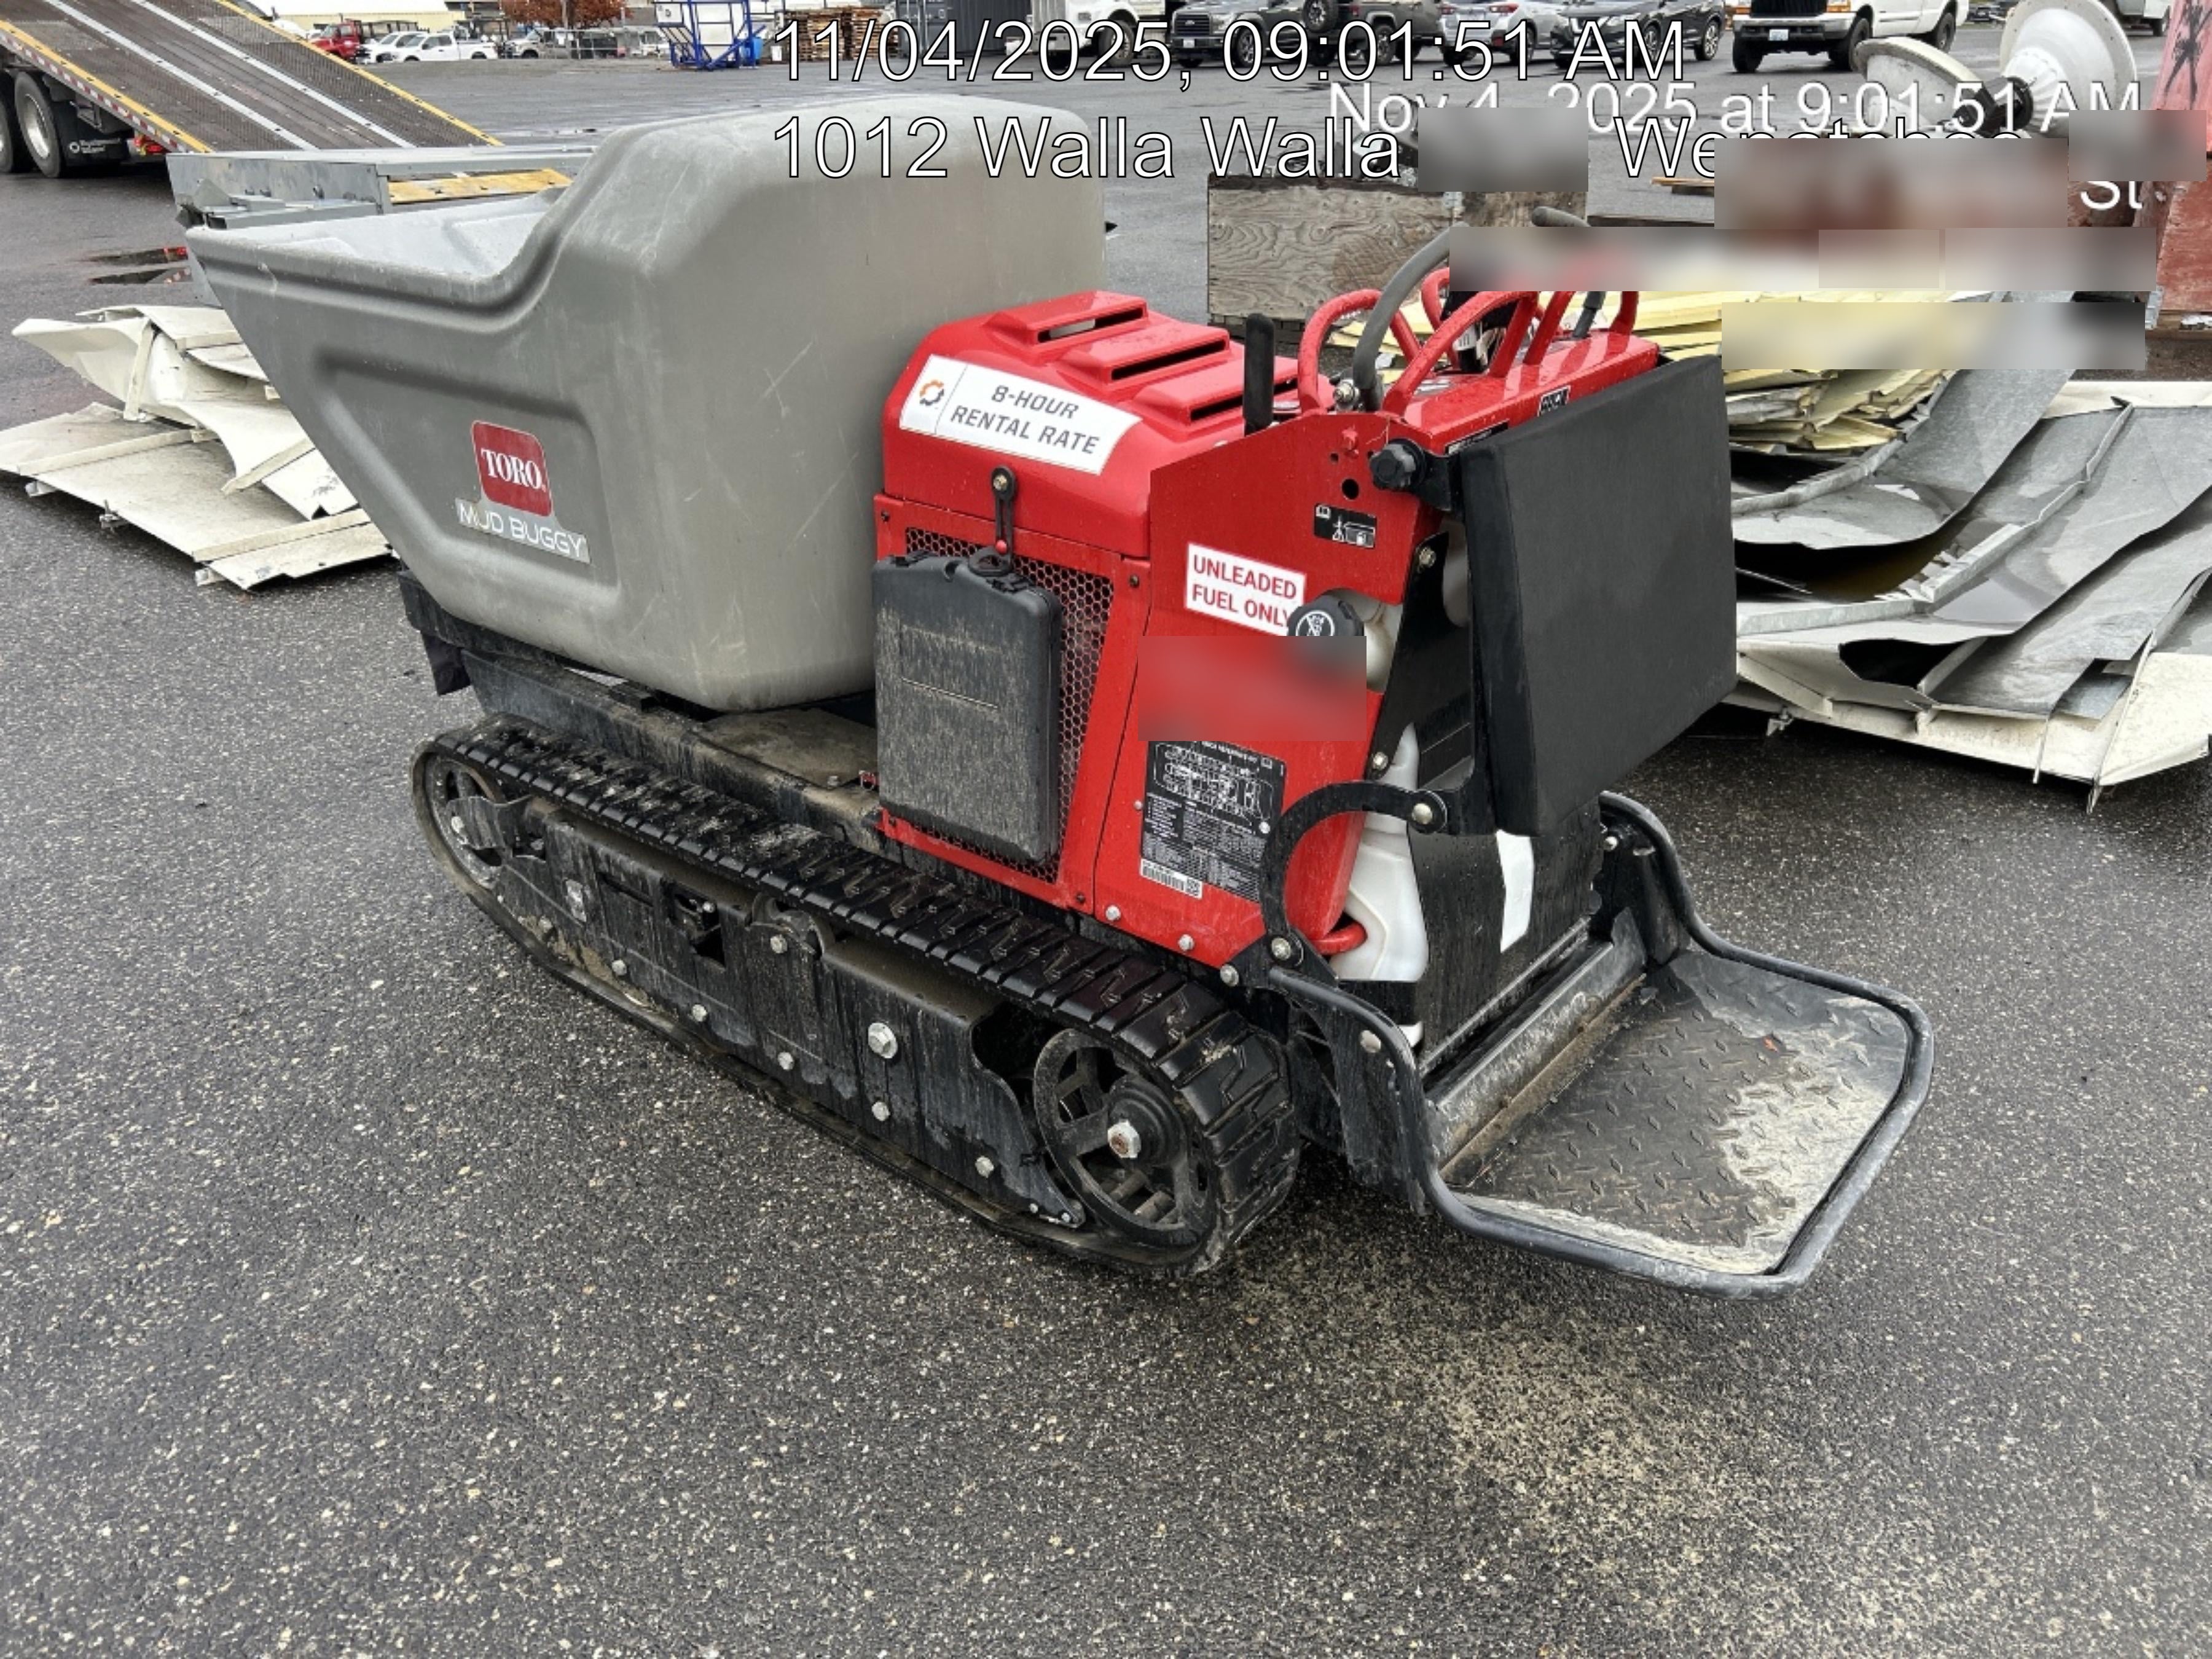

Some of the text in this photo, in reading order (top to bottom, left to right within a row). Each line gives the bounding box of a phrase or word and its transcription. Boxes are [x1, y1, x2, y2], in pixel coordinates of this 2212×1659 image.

[991, 385, 1079, 419] 8-HOUR
[951, 406, 1099, 455] RENTAL RATE
[509, 515, 585, 557] BUGGY
[1193, 554, 1297, 600] UNLEADED
[1192, 584, 1239, 613] FUEL
